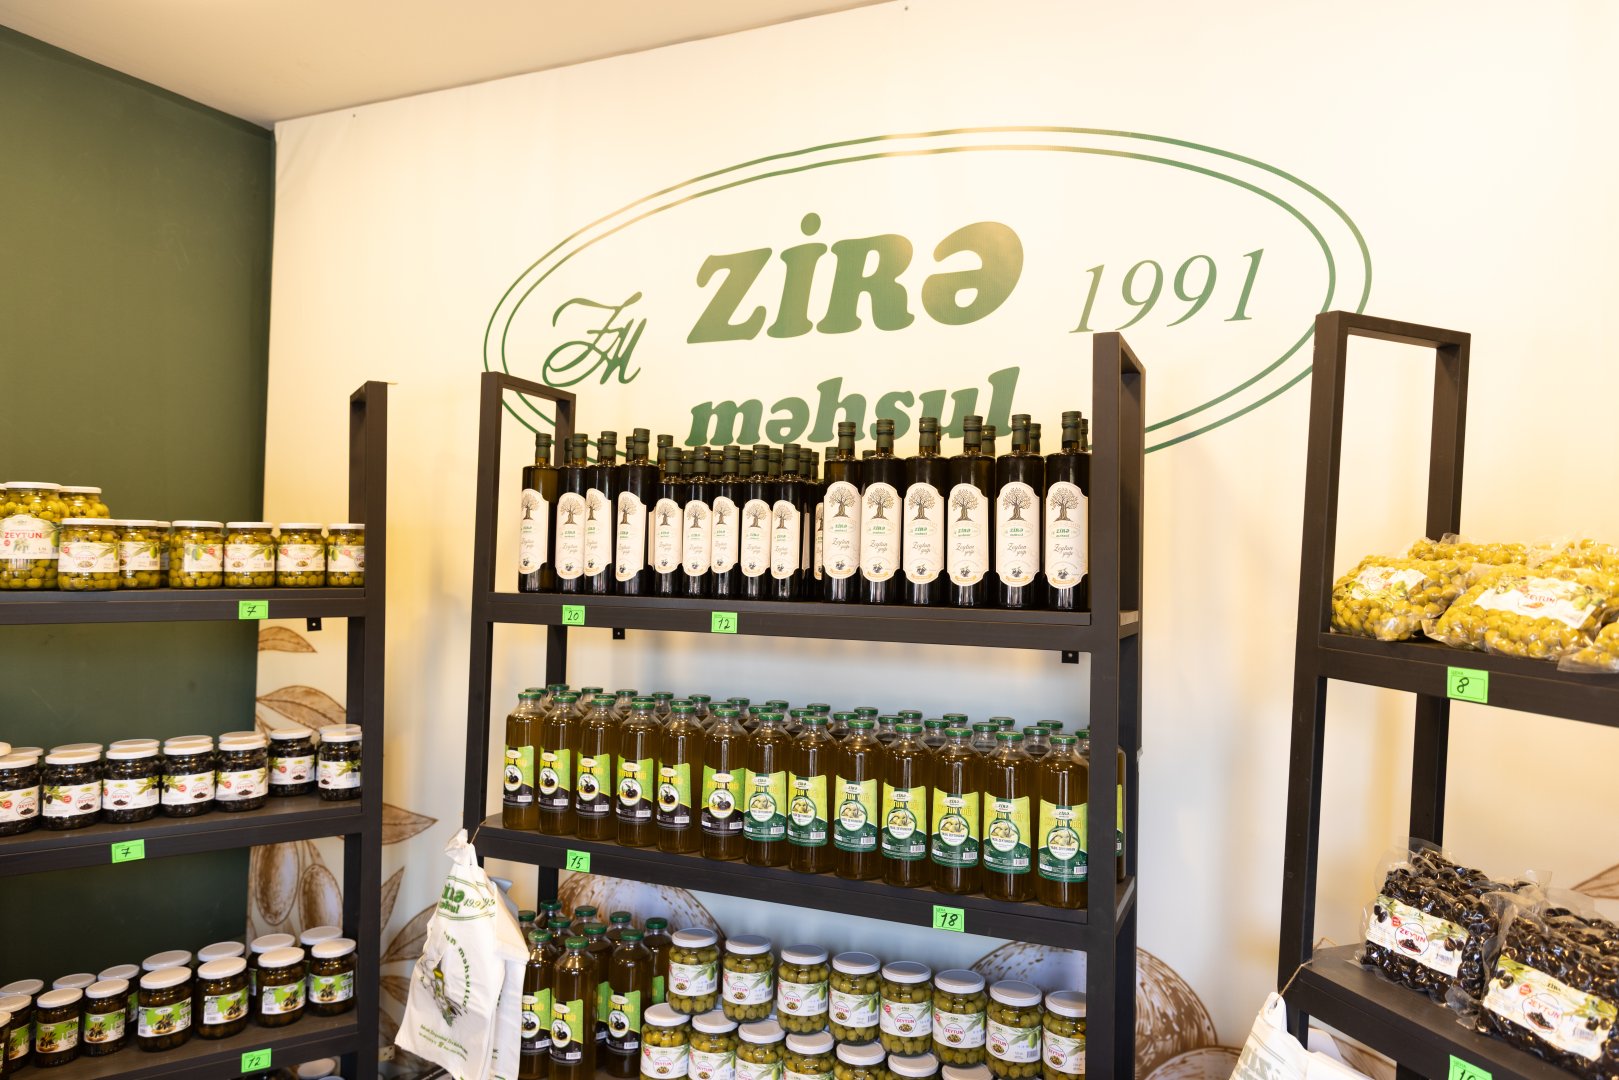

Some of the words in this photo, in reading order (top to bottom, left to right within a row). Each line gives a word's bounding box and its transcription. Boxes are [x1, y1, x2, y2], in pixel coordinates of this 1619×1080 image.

[1068, 248, 1265, 333] 1991
[684, 366, 1021, 446] məhsul
[4, 531, 43, 539] ZEYTUN
[247, 605, 257, 616] 7
[568, 611, 579, 621] 20
[718, 617, 731, 630] 12
[1457, 677, 1469, 693] 8
[121, 847, 132, 858] 7
[571, 856, 583, 869] 15
[941, 912, 958, 928] 18
[248, 1056, 261, 1069] 12
